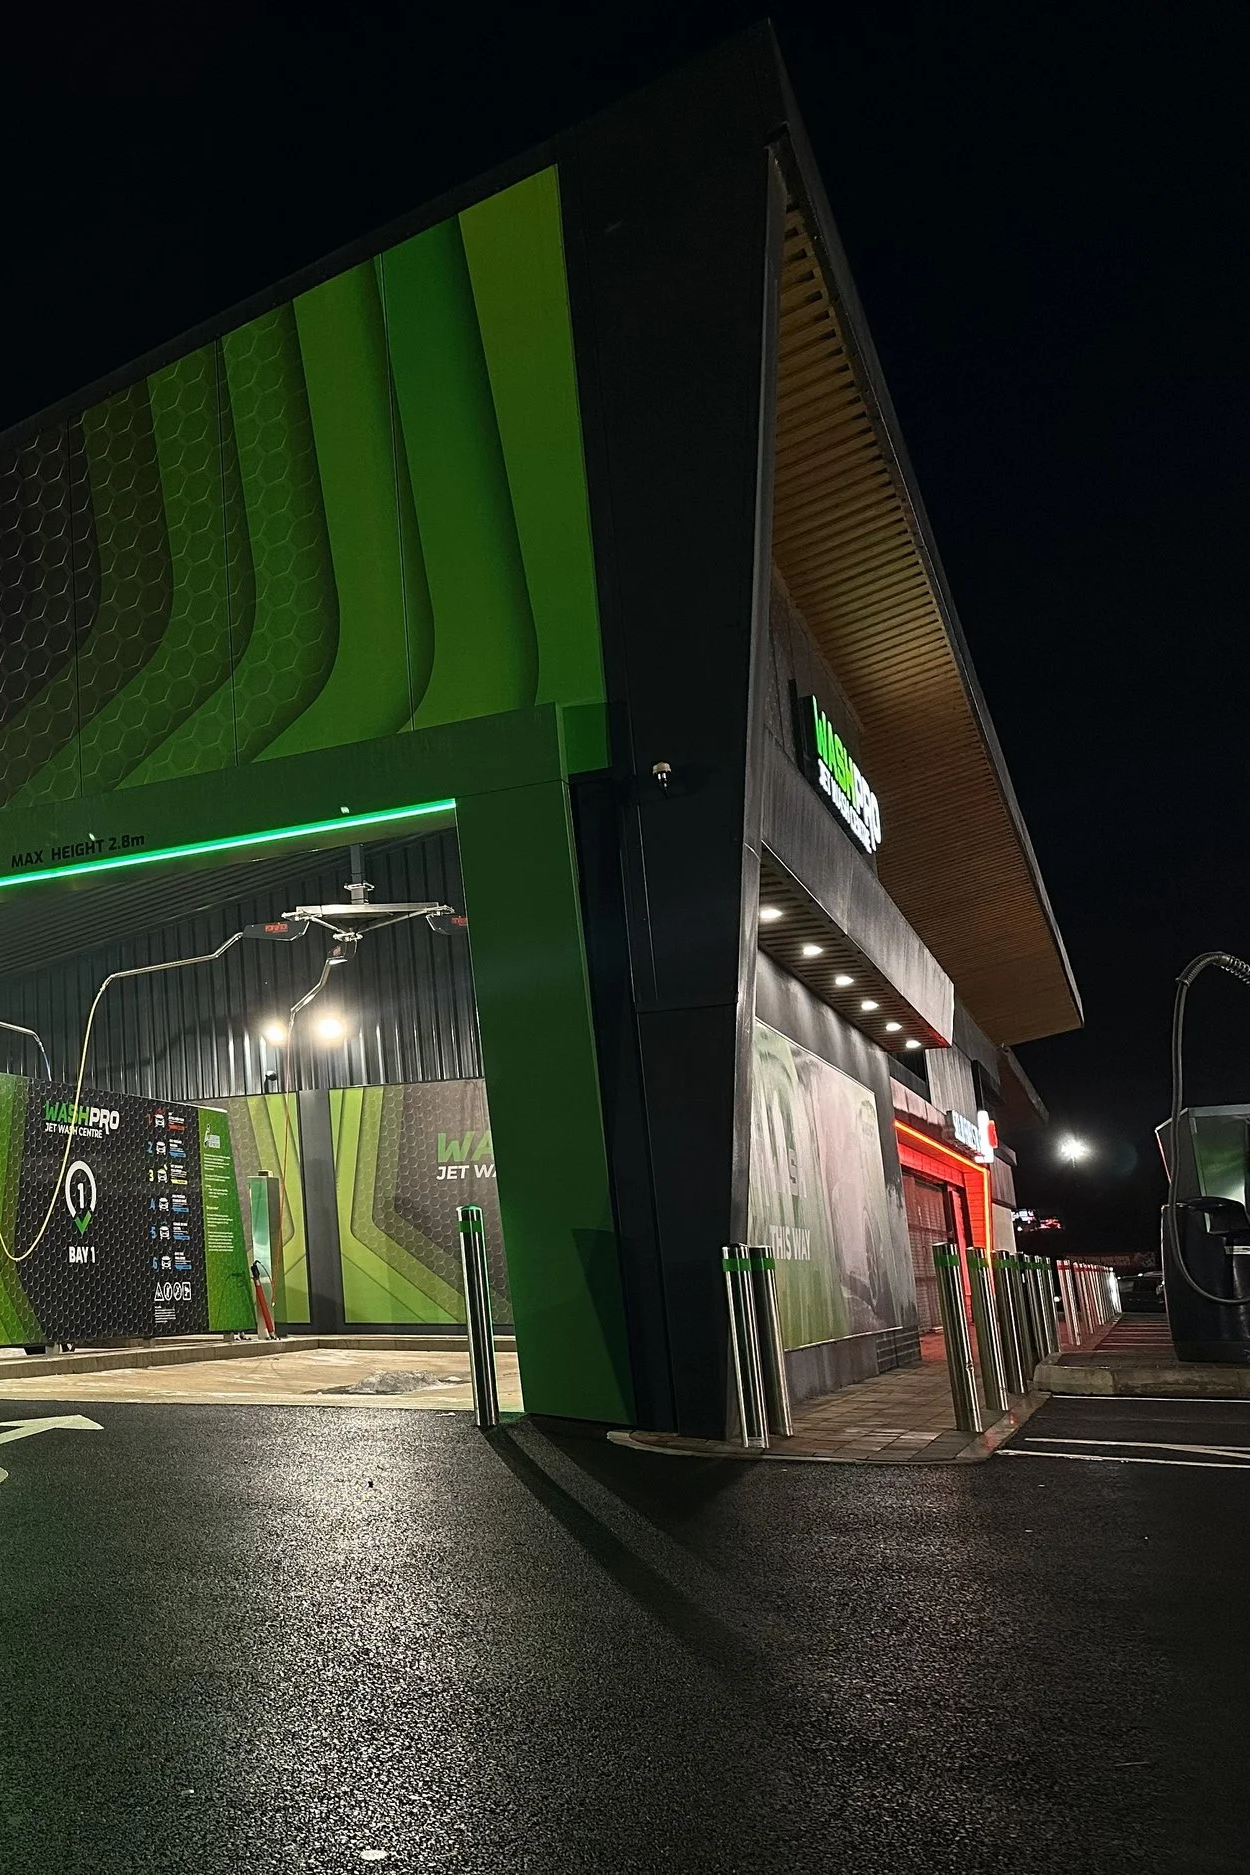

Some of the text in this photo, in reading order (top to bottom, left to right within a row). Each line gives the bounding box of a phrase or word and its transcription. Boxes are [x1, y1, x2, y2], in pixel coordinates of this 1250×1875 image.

[812, 695, 882, 852] WASHPRO
[11, 834, 145, 868] MAX HEIGHT 2.8m
[45, 1100, 120, 1135] WASHPRO
[45, 1122, 57, 1133] JET
[78, 1127, 103, 1139] CENTRE
[148, 1169, 154, 1181] 3
[436, 1165, 470, 1180] JET
[77, 1182, 85, 1209] 1
[150, 1226, 157, 1239] 5
[770, 1224, 811, 1260] THIS WAY
[68, 1246, 96, 1264] BAY 1
